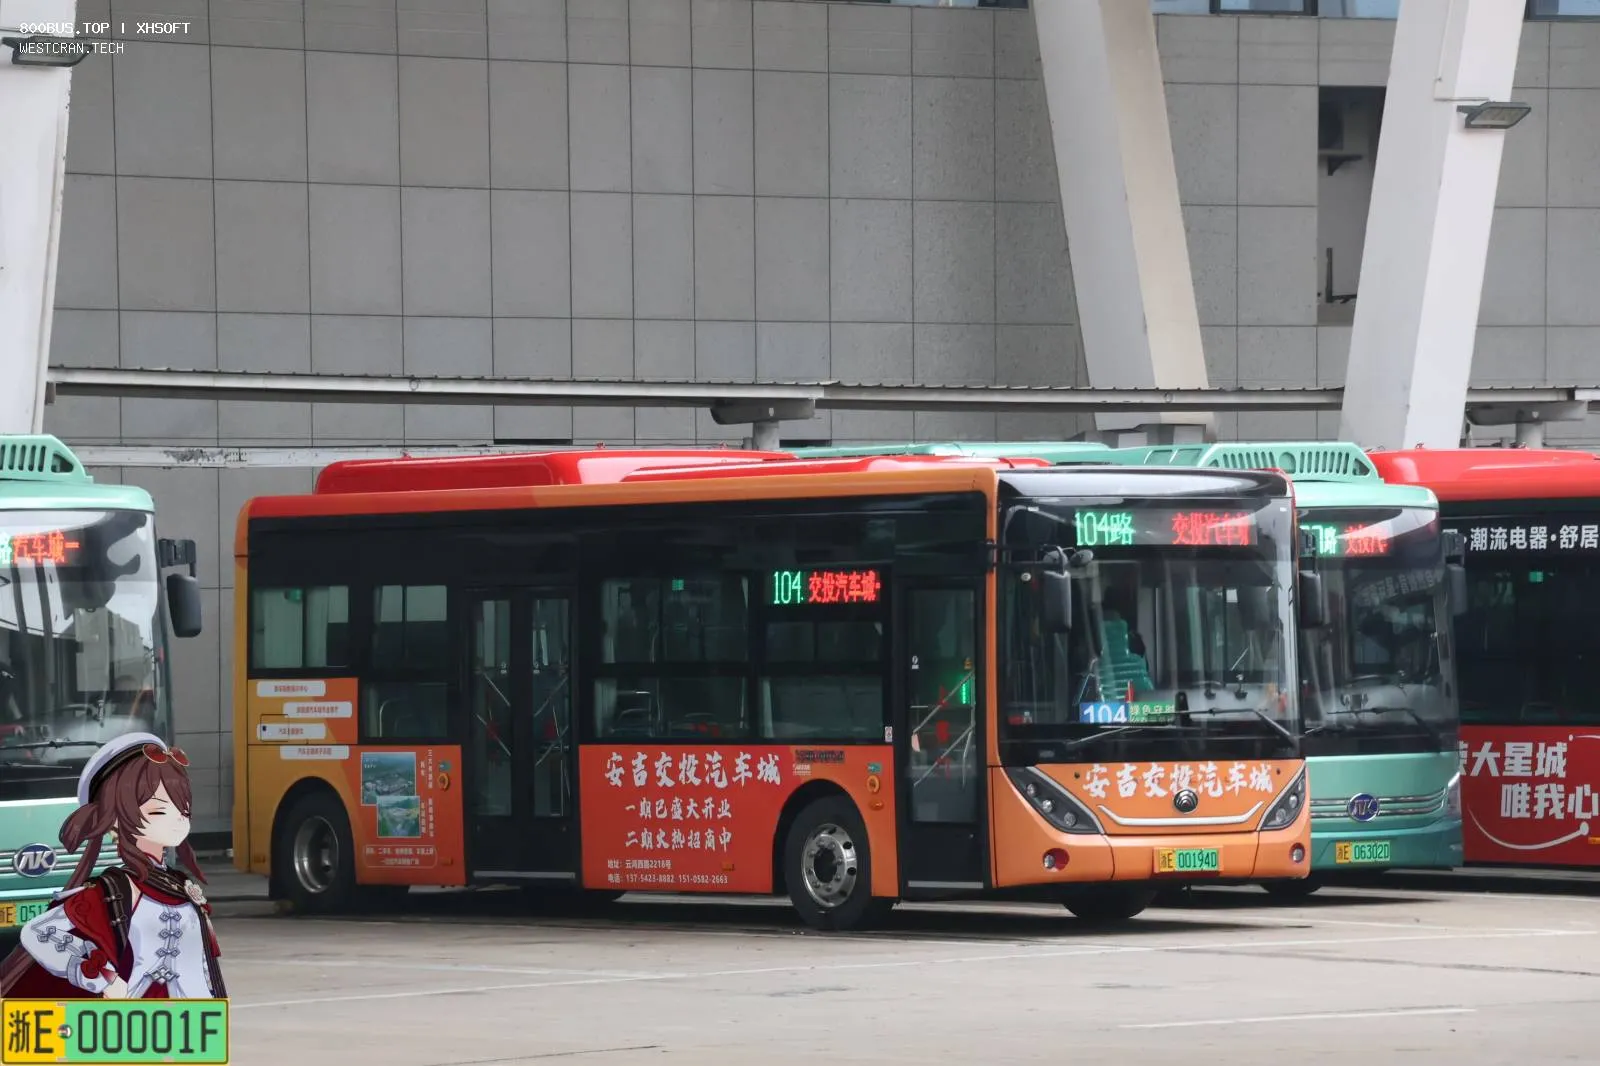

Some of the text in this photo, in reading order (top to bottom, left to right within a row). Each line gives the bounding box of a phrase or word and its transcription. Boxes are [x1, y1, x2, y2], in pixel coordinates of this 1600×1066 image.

[1083, 704, 1127, 723] 104
[605, 751, 781, 788] 安吉交投汽车城
[1083, 762, 1273, 798] 安吉交投汽车城
[624, 796, 732, 821] 一期已盛大开业
[624, 826, 732, 852] 二期火热招商中
